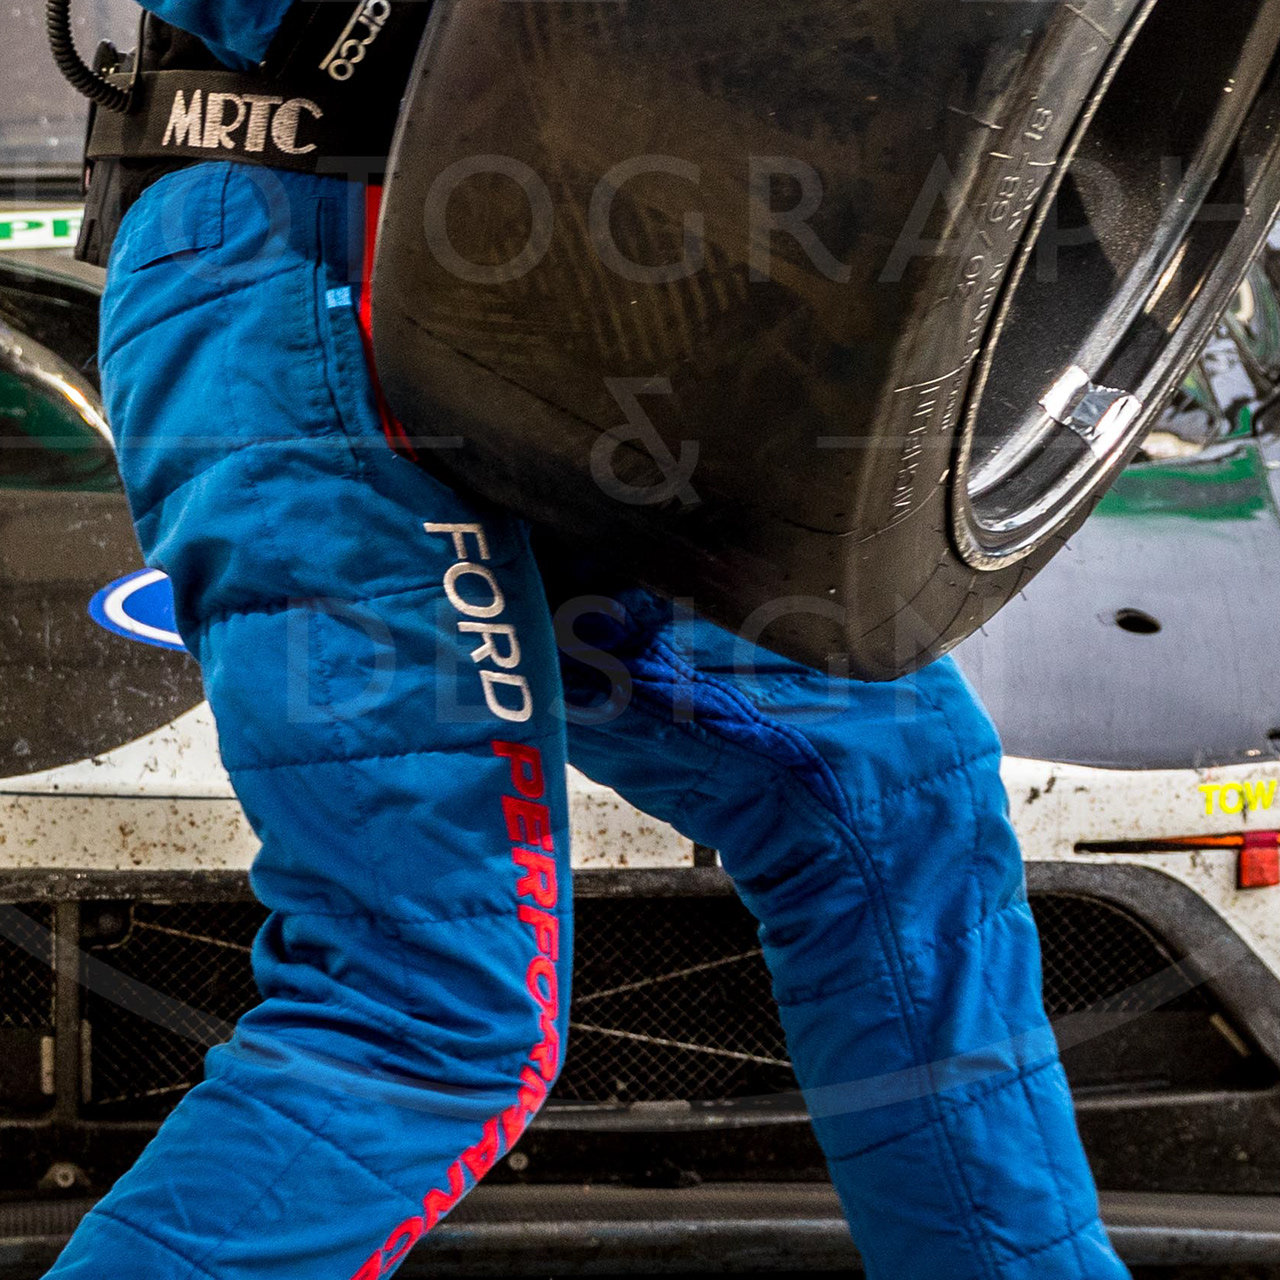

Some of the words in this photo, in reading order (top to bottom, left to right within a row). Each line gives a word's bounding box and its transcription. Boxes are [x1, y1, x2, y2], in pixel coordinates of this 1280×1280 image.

[162, 88, 324, 155] MRTC
[422, 520, 534, 723] FORD
[1198, 780, 1278, 816] TOW
